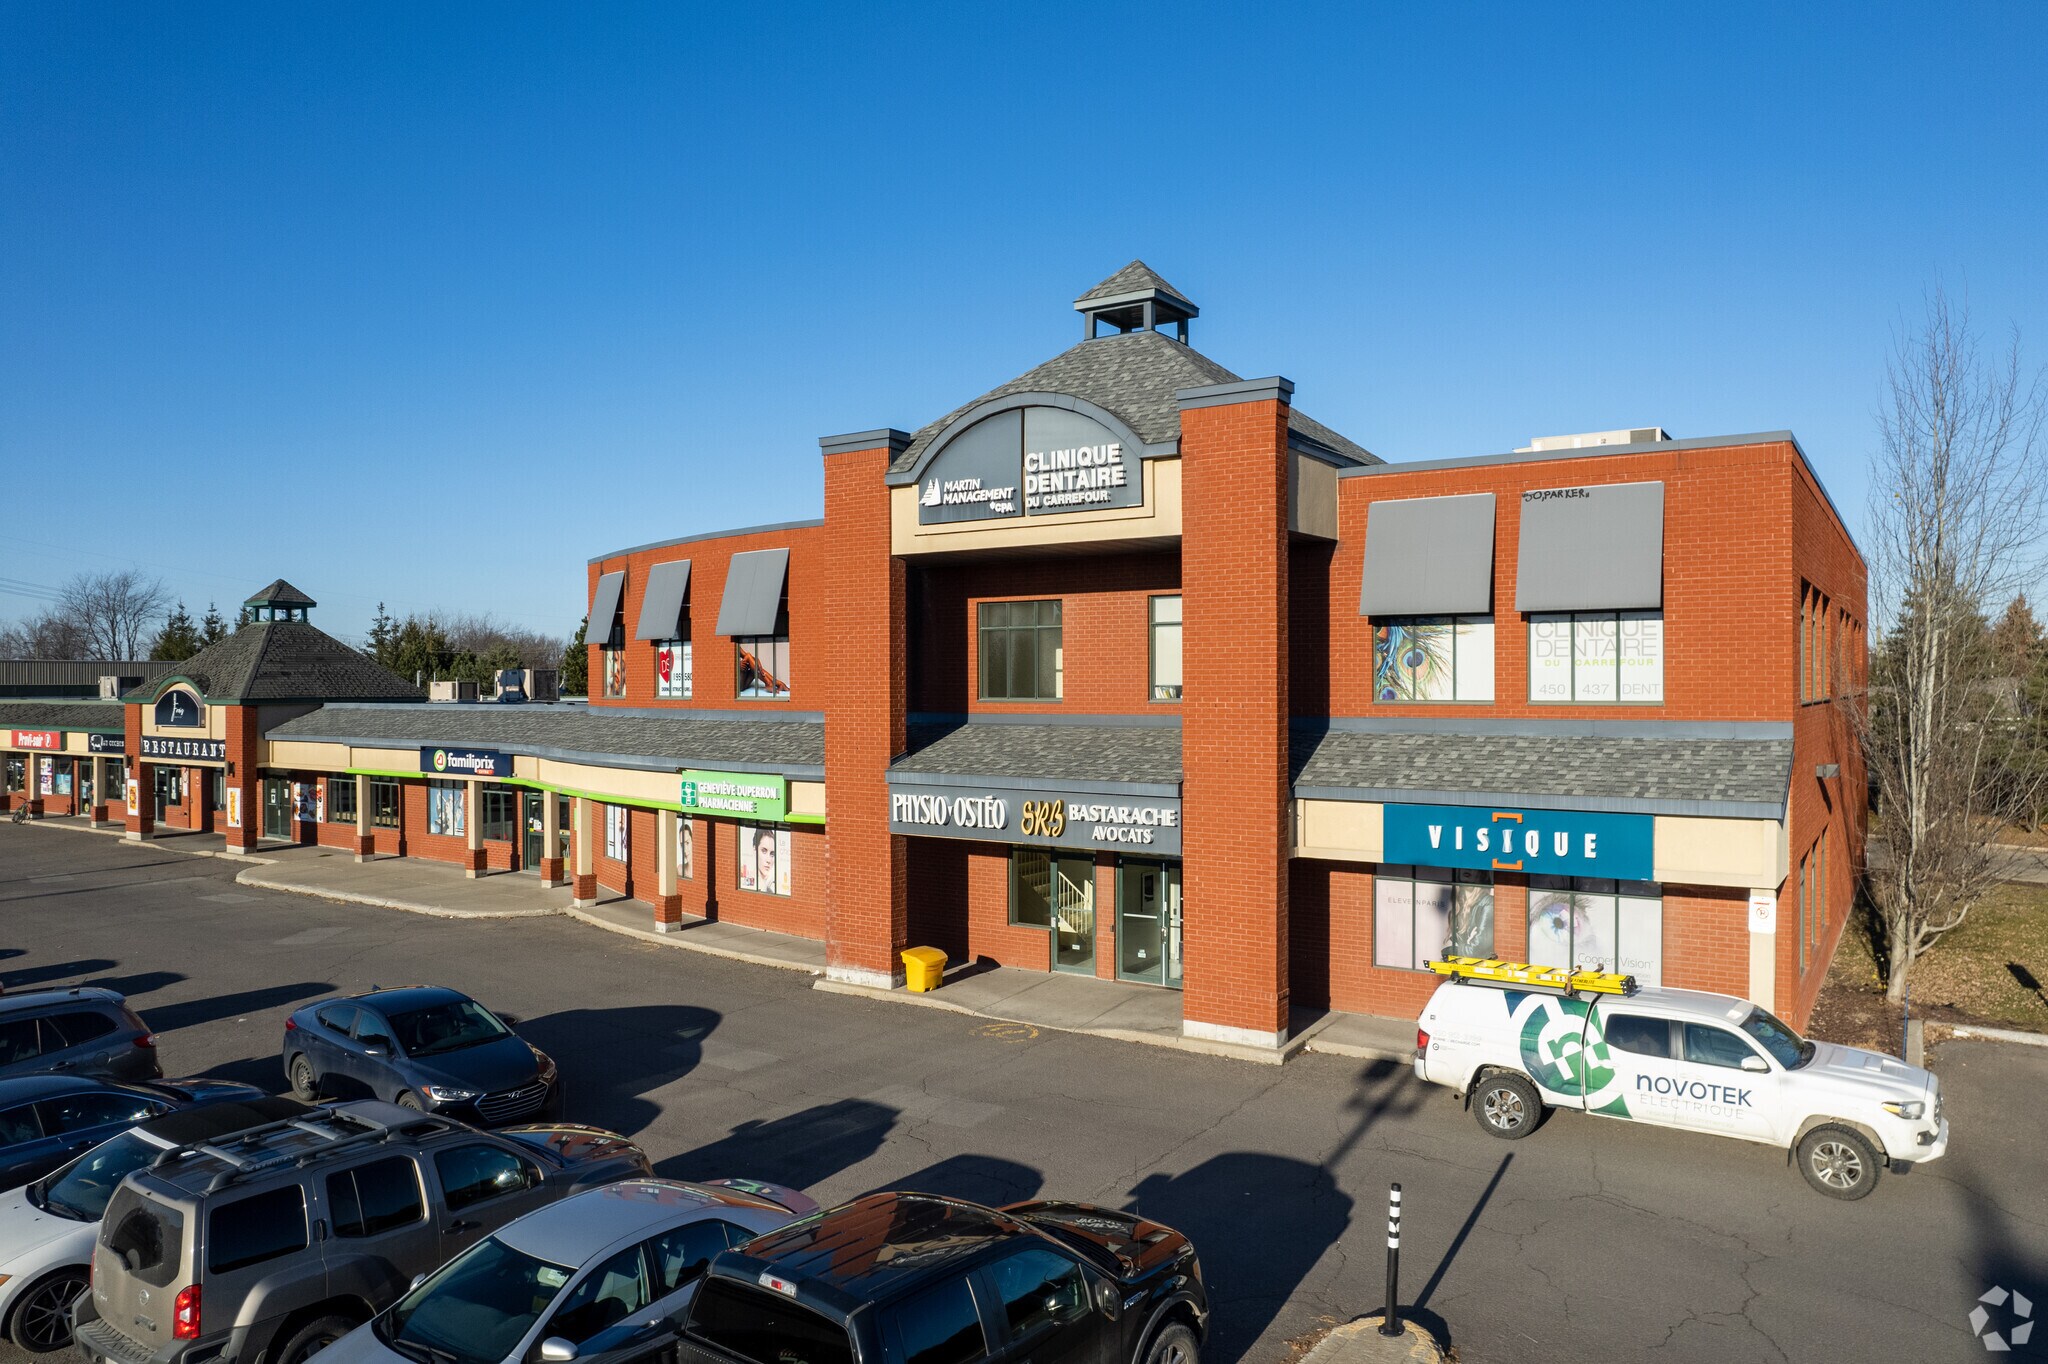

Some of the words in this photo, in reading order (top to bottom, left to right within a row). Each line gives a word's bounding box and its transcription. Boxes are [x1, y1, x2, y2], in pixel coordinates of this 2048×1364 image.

[1025, 443, 1121, 472] CLINIQUE
[944, 478, 981, 492] MARTIN
[1025, 465, 1125, 494] DENTAIRE
[943, 487, 1014, 504] MANAGEMENT
[1025, 496, 1040, 507] DU
[1043, 490, 1109, 506] CARREFOUR
[994, 502, 1014, 513] CPA
[1535, 617, 1657, 638] CLINIQUE
[1536, 637, 1657, 658] DENTAIRE
[1544, 659, 1560, 667] DU
[1574, 658, 1654, 667] CARREFOUR
[1539, 683, 1566, 695] 450
[1582, 683, 1609, 695] 437
[1622, 683, 1660, 695] DENT
[18, 732, 43, 747] Provi-soir
[143, 740, 225, 757] RESTAURANT
[447, 752, 494, 773] familiprix
[699, 780, 735, 797] GENEVIÈVE
[737, 786, 777, 799] DUPERRON
[699, 797, 754, 812] PHARMACIENNE
[1069, 804, 1177, 827] BASTARACHE
[1092, 826, 1152, 843] AVOCATS
[1428, 825, 1597, 858] VISIQUE
